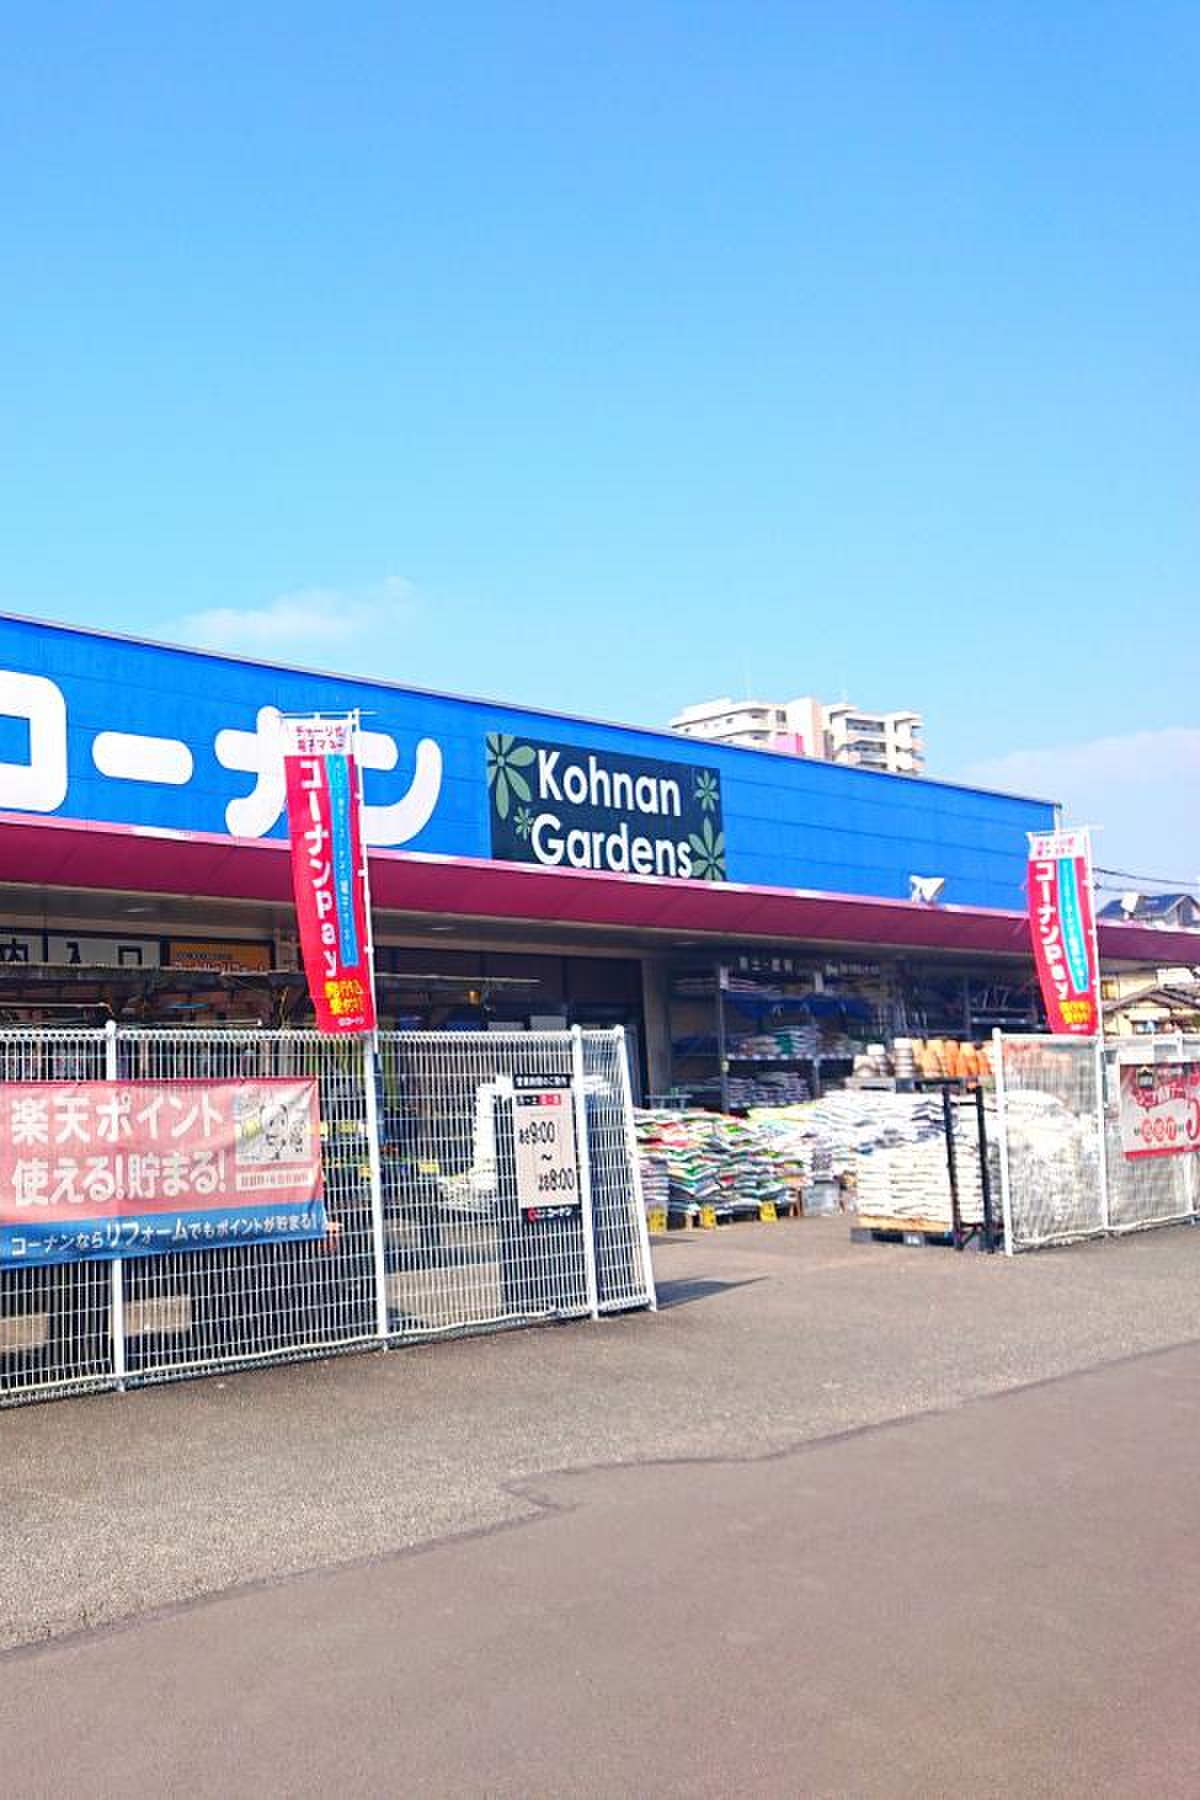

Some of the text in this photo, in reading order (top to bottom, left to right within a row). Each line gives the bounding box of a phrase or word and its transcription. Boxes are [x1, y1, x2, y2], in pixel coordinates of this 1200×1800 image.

[537, 749, 682, 817] Kohnan
[530, 812, 693, 879] Gardens
[10, 1095, 224, 1146] 楽天ポイント
